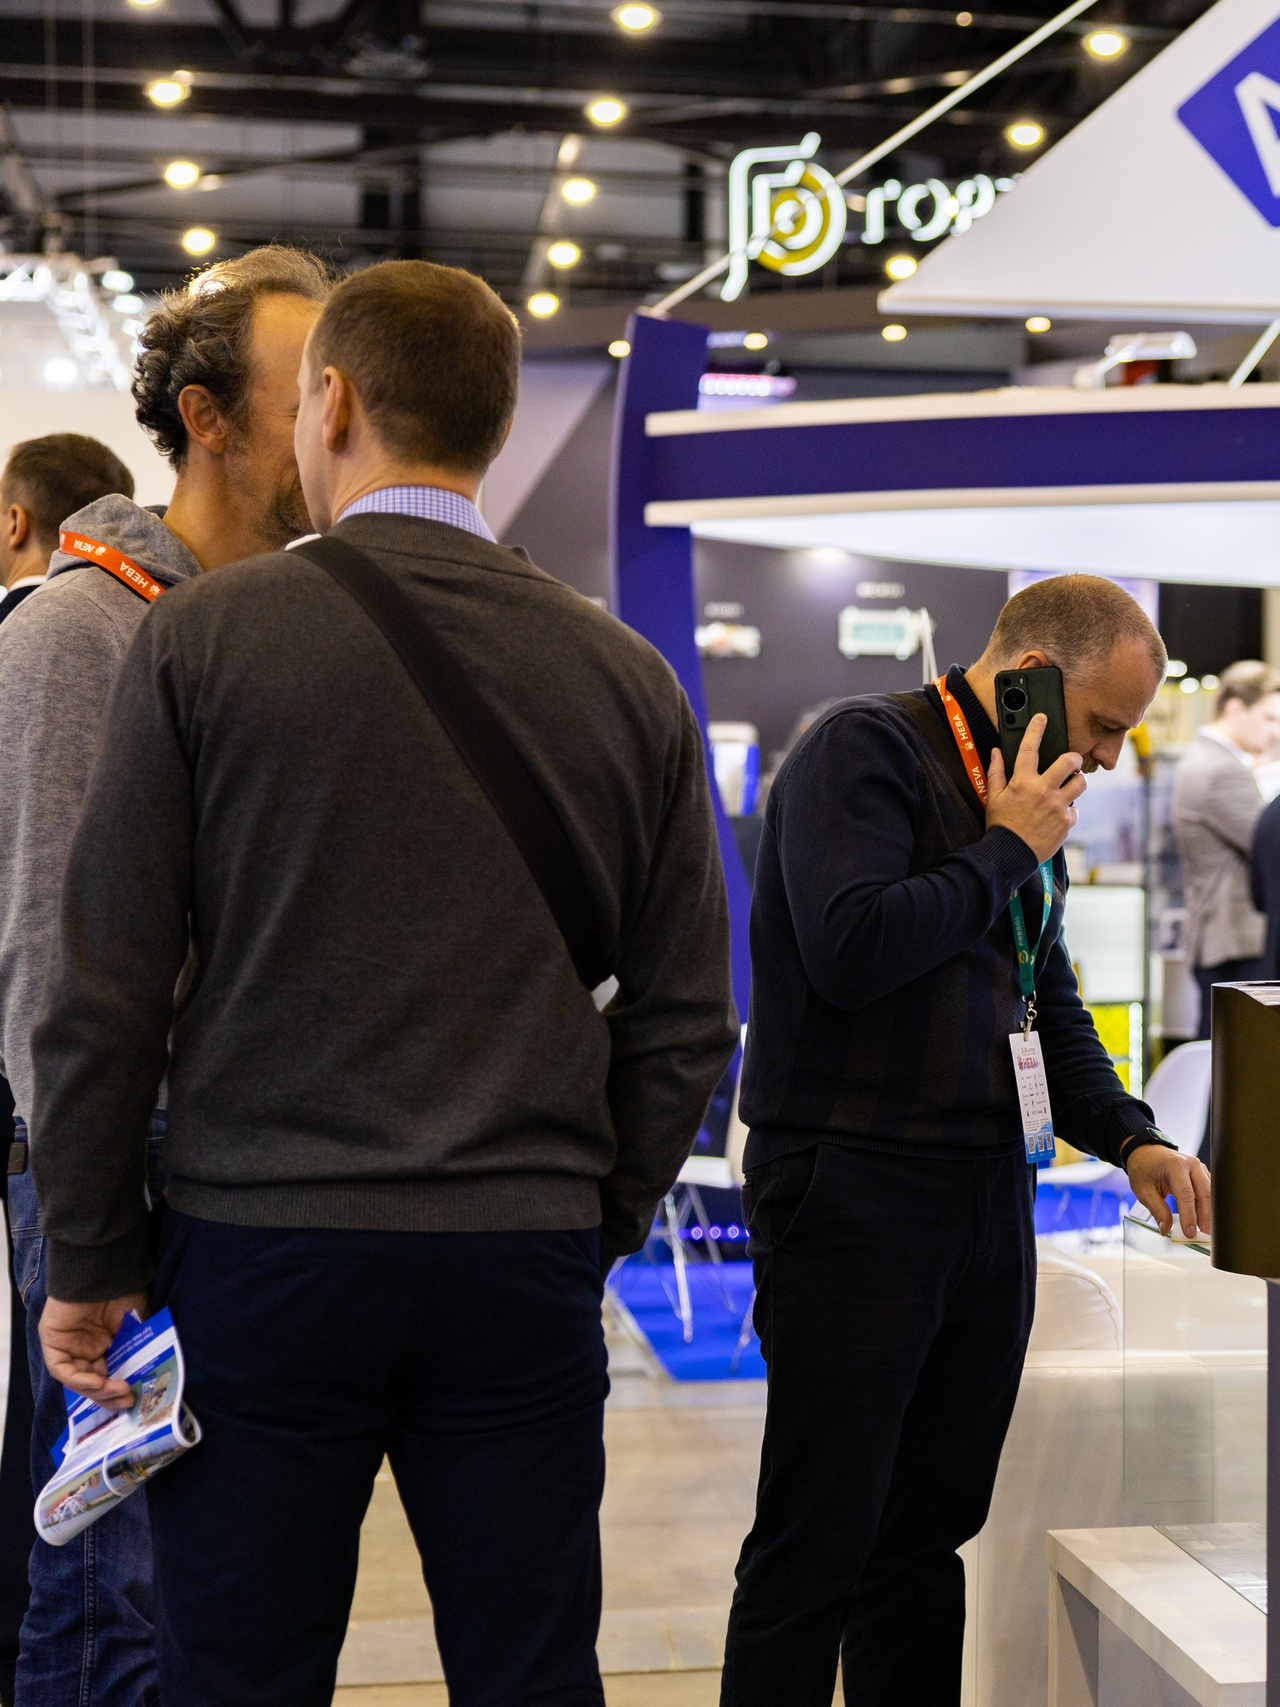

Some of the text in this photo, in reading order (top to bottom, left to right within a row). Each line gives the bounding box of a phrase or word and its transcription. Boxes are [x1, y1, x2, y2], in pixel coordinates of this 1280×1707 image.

[73, 540, 95, 553] NEVA
[972, 766, 986, 793] NEVA
[1015, 916, 1024, 946] PREGOL
